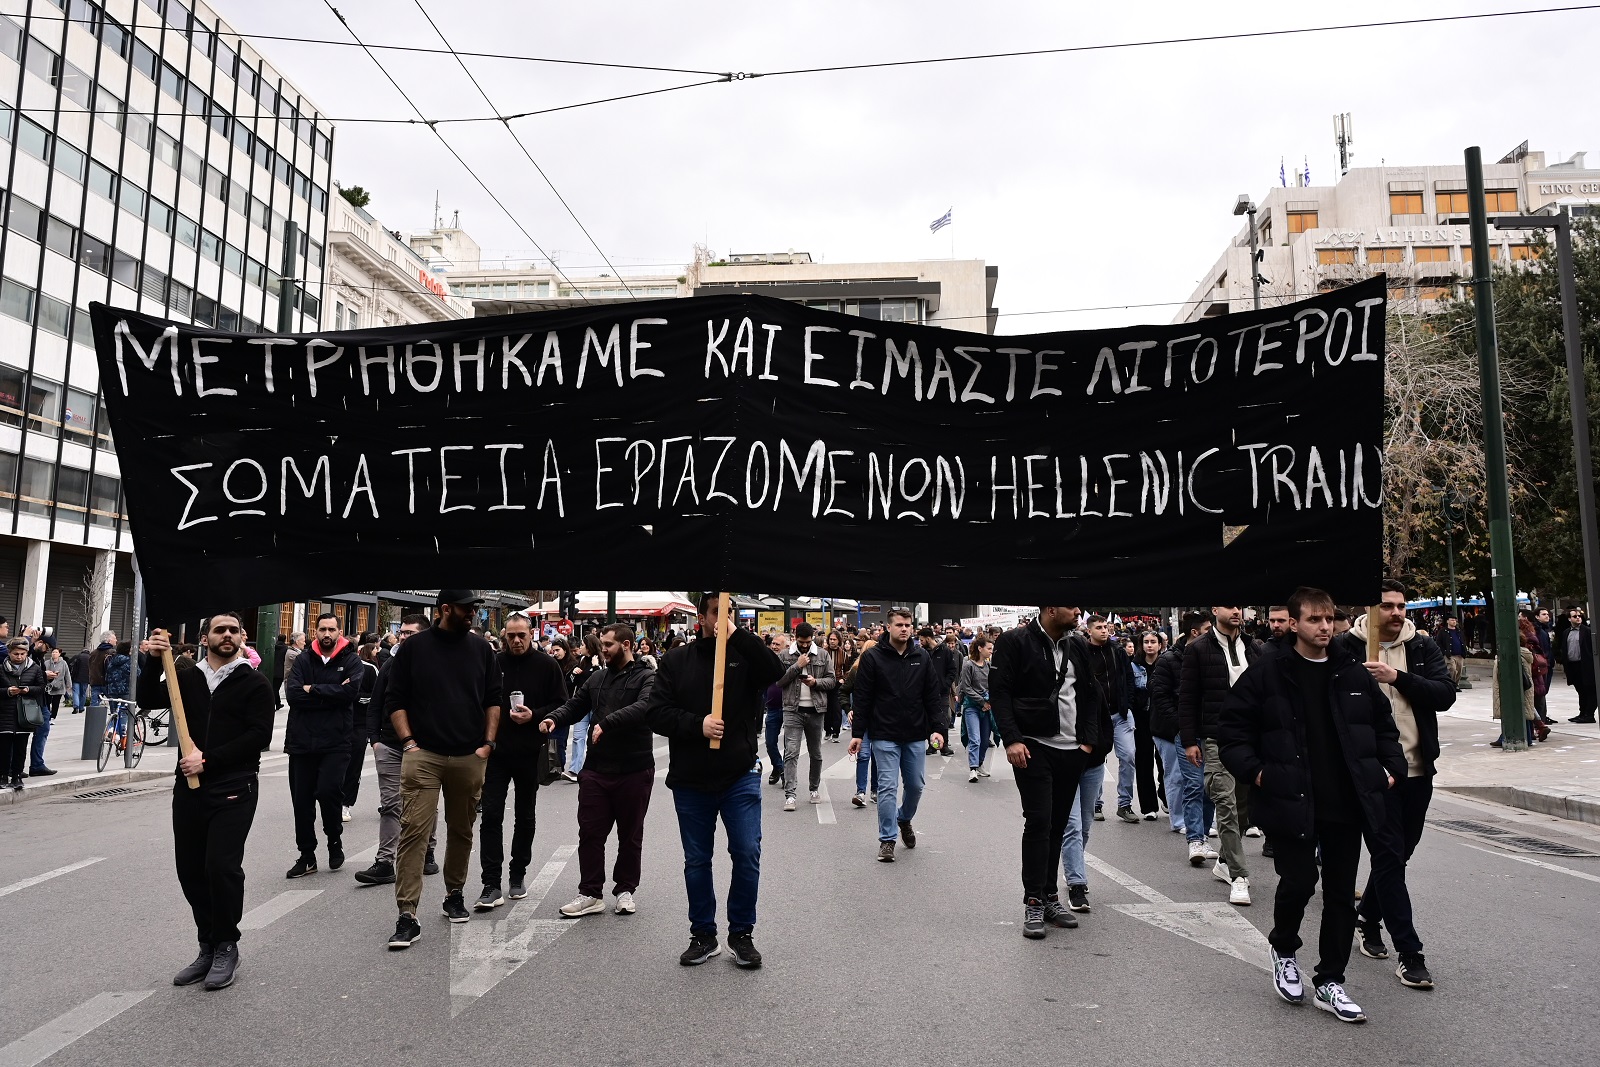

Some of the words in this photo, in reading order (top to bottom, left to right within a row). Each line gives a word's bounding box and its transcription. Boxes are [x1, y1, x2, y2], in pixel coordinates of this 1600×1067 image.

[1540, 184, 1574, 195] KING
[1371, 227, 1463, 243] ATHENS
[114, 319, 668, 398] ΜΕΤΡΗΘΗΚΑΜΕ
[704, 317, 780, 380] ΚΑΙ
[804, 326, 1065, 403] ΕΙΜΑΣΤΕ
[1087, 298, 1384, 395] ΛΙΓΟΤΕΡΟΙ
[170, 439, 564, 530] ΣΩΜΑΤΕΙΑ
[596, 437, 965, 521] ΕΡΓΑΖΟΜΕΝΩΝ
[991, 447, 1224, 520] HELLENIC
[1237, 443, 1384, 510] TRAIN
